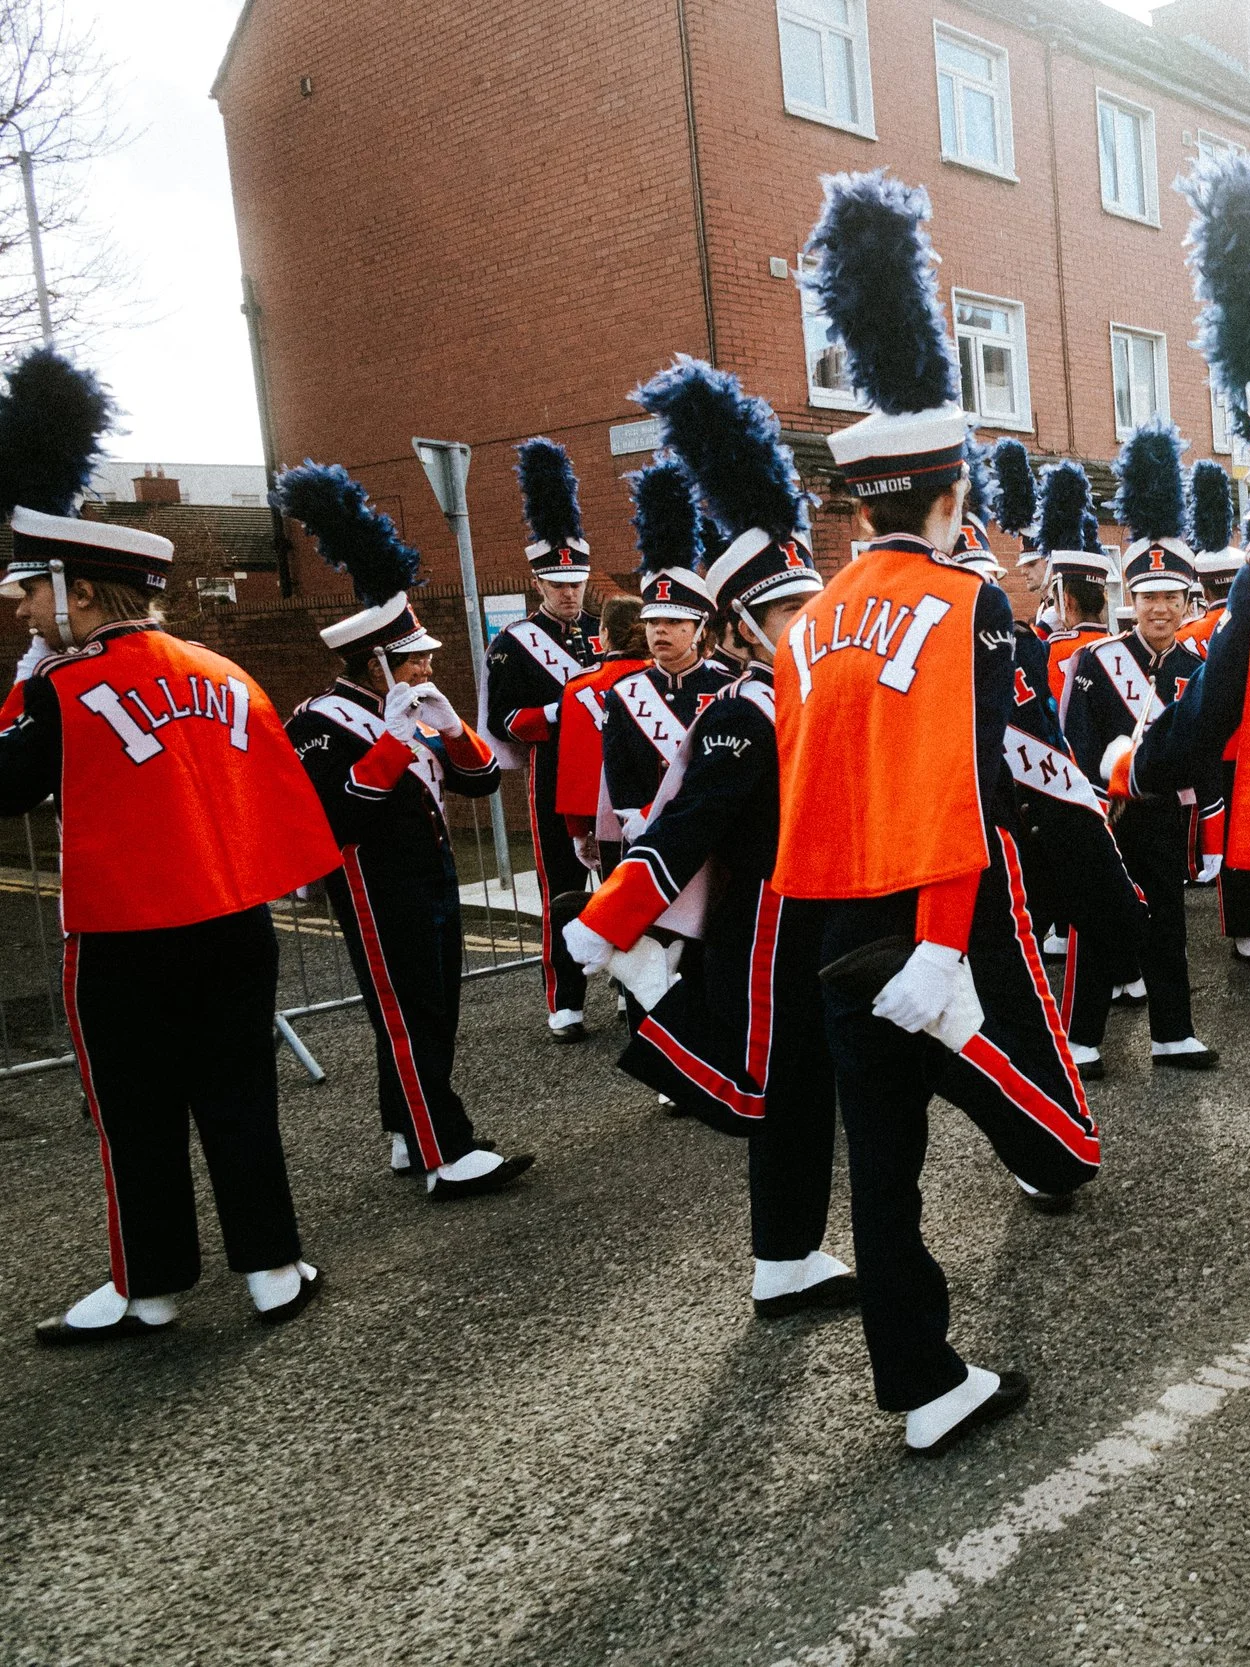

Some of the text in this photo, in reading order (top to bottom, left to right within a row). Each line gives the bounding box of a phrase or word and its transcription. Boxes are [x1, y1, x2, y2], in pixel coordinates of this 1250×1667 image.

[856, 476, 912, 497] ILLINOIS
[960, 525, 983, 549] I
[559, 549, 572, 565] I
[779, 541, 805, 569] I
[1150, 550, 1165, 570] I
[656, 581, 671, 600] I
[788, 593, 953, 705] ILLINI
[1014, 666, 1036, 707] I
[79, 675, 250, 767] ILLINI
[702, 735, 751, 757] ILLINI
